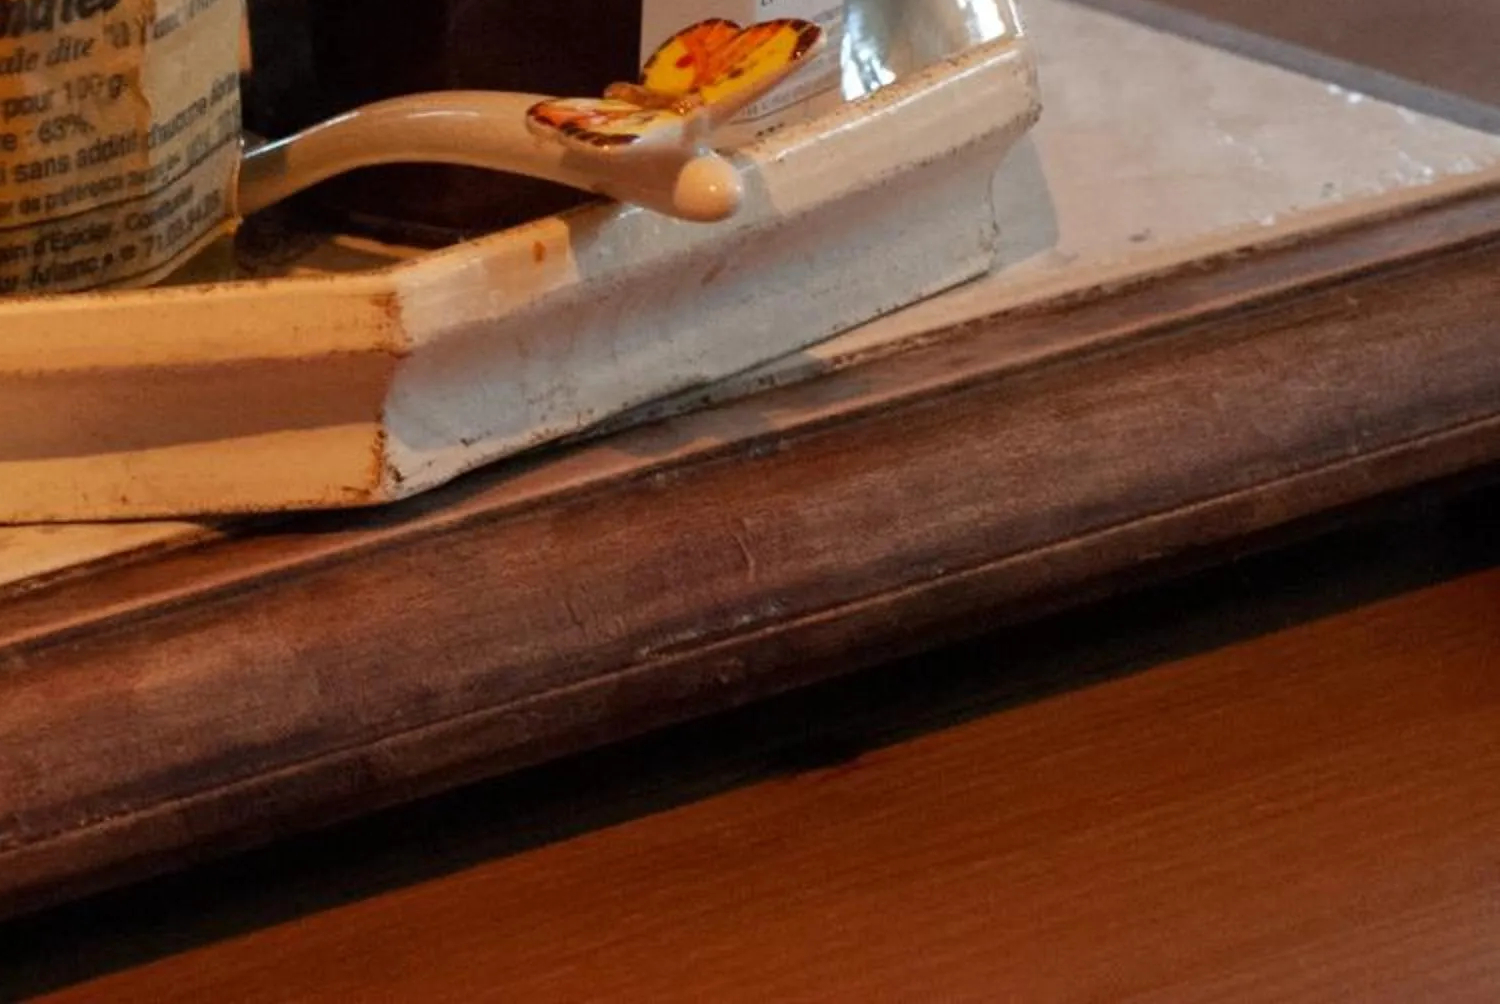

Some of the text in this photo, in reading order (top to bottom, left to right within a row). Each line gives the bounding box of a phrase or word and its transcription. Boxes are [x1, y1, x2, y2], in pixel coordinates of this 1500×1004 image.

[45, 36, 94, 67] dite
[3, 90, 54, 124] pour
[15, 155, 70, 184] sans
[76, 129, 140, 170] additif
